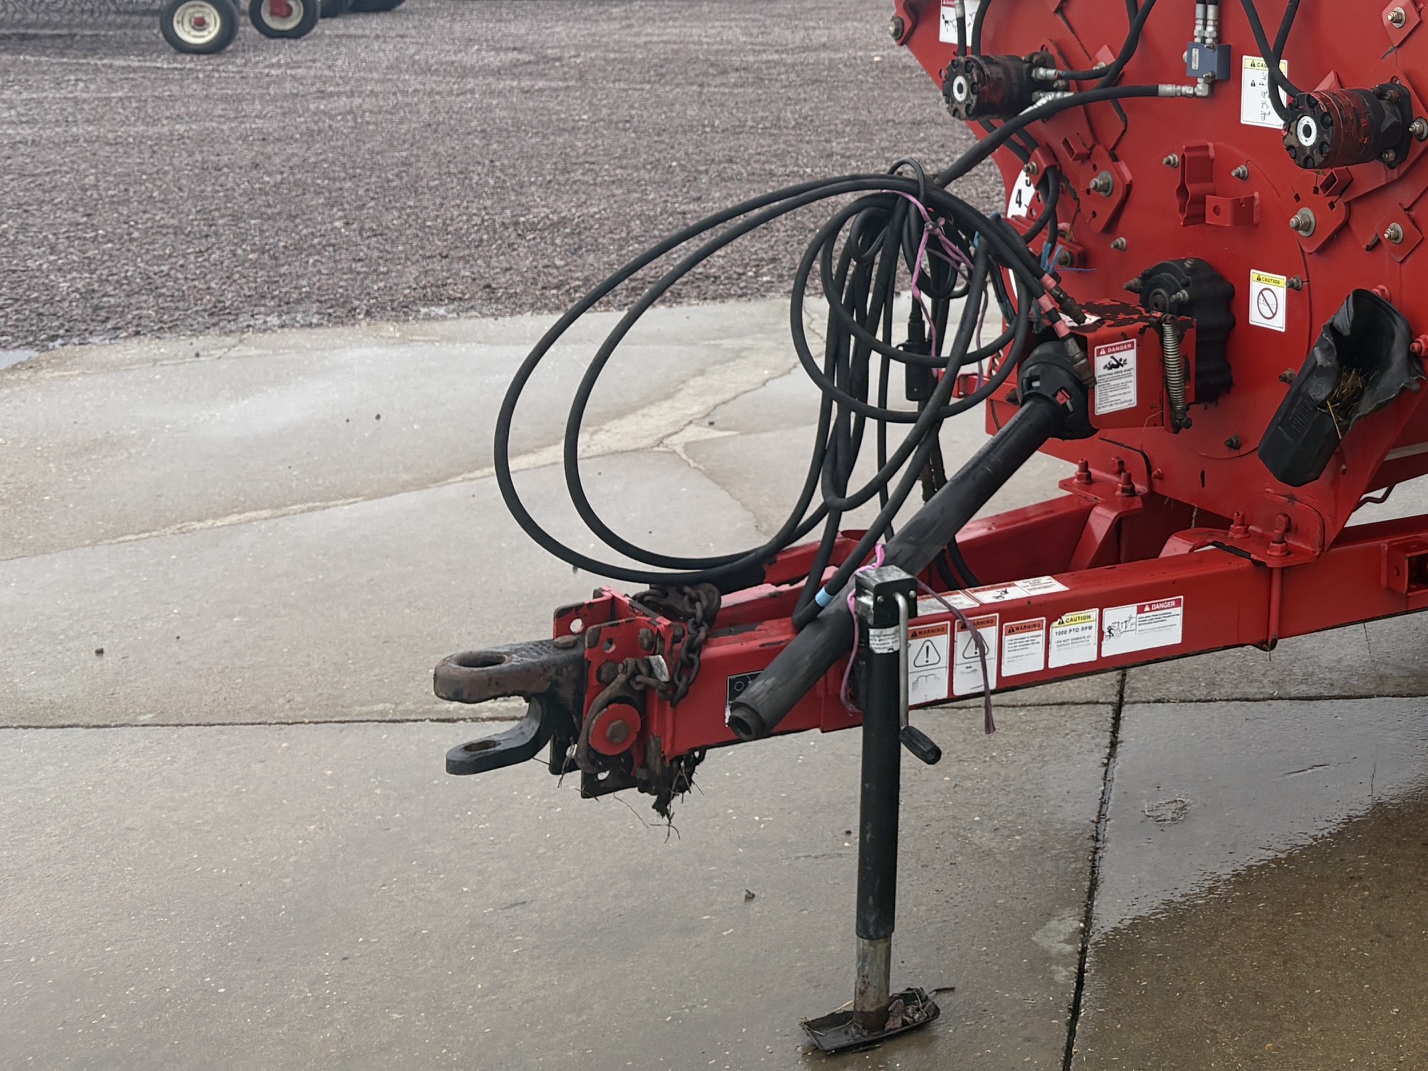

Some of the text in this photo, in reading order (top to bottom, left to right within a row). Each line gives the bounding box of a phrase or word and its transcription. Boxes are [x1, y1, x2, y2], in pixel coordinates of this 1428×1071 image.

[1015, 188, 1023, 208] 4
[1262, 276, 1280, 285] CAUTION
[1107, 343, 1132, 353] DANGER
[1151, 600, 1176, 611] DANGER
[1065, 614, 1091, 623] CAUTION
[918, 627, 945, 635] WARNING
[1015, 622, 1040, 631] WARNING
